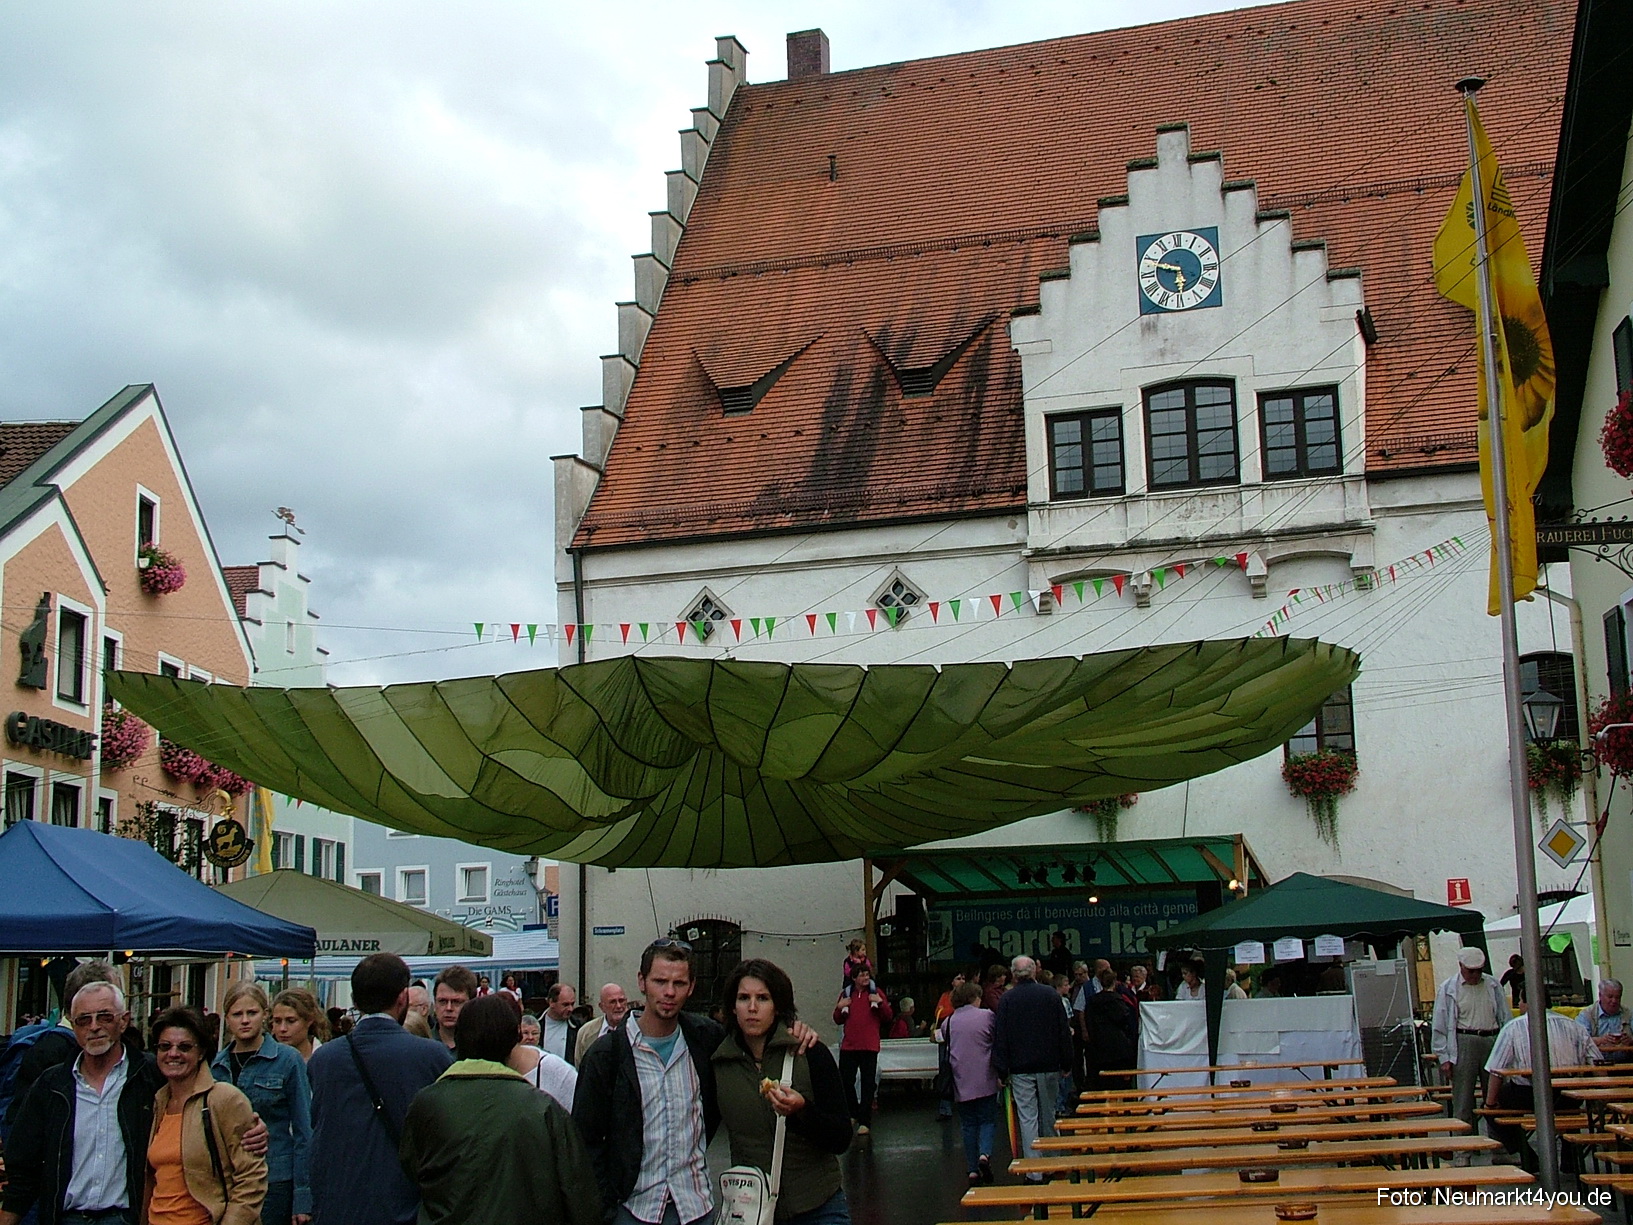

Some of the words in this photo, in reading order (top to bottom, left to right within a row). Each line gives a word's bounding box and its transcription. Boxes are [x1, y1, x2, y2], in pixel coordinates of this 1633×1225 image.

[1536, 530, 1597, 543] RAUEREI
[468, 907, 482, 916] Die
[484, 906, 512, 916] GAMS
[1044, 905, 1106, 918] benvenuto
[1109, 903, 1130, 916] alla
[1133, 902, 1159, 915] città
[1162, 903, 1199, 918] gemel
[314, 939, 380, 951] AULANER
[979, 923, 1081, 958] Garda
